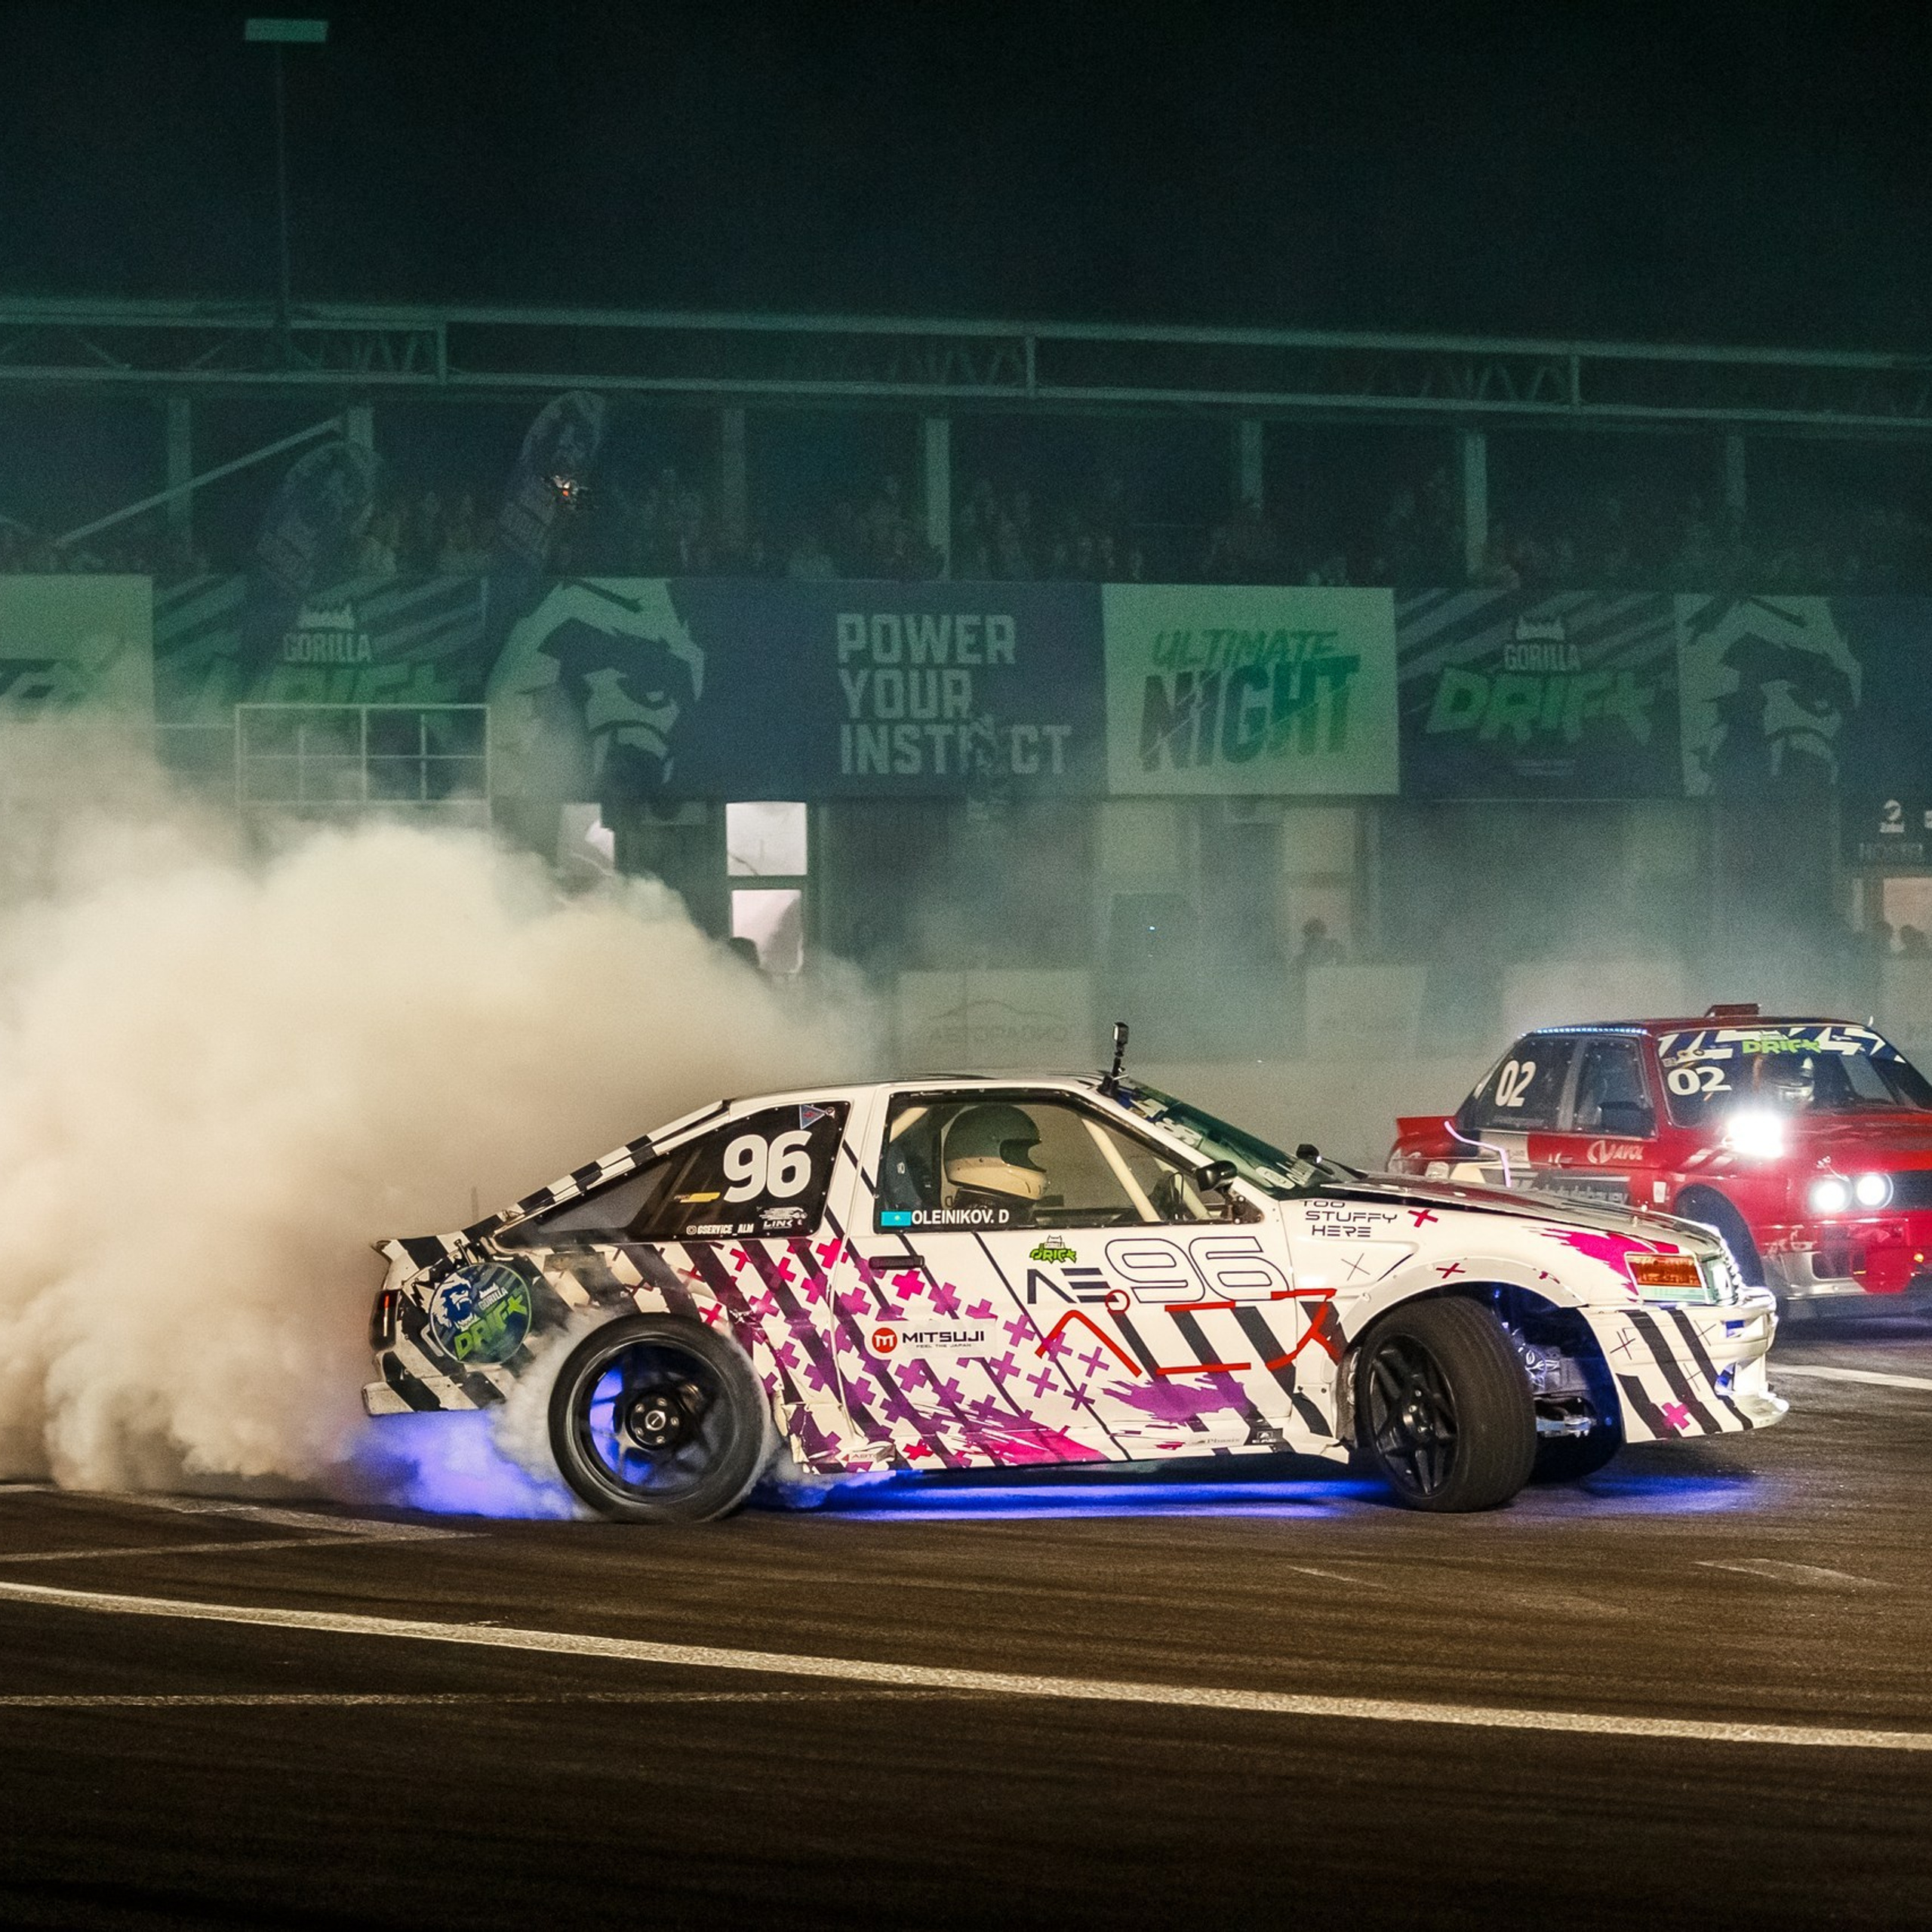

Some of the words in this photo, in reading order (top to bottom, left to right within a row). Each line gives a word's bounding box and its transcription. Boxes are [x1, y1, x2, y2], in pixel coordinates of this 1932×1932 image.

[283, 633, 372, 662] GORILLA
[836, 613, 1016, 664] POWER
[1152, 629, 1338, 670] ULTIMATE
[1505, 644, 1582, 671] GORILLA
[838, 669, 972, 719] YOUR
[1140, 654, 1361, 772] NIGHT
[841, 724, 1072, 775] INSTICT
[1495, 1060, 1537, 1106] 02
[1667, 1066, 1732, 1095] 02
[724, 1130, 813, 1203] 96
[912, 1209, 995, 1225] OLEINIKOV.
[998, 1209, 1010, 1223] D
[1305, 1211, 1398, 1223] STUFFY
[1312, 1225, 1371, 1238] HERE
[478, 1287, 509, 1311] GORILLA
[903, 1331, 984, 1343] MITSUJI
